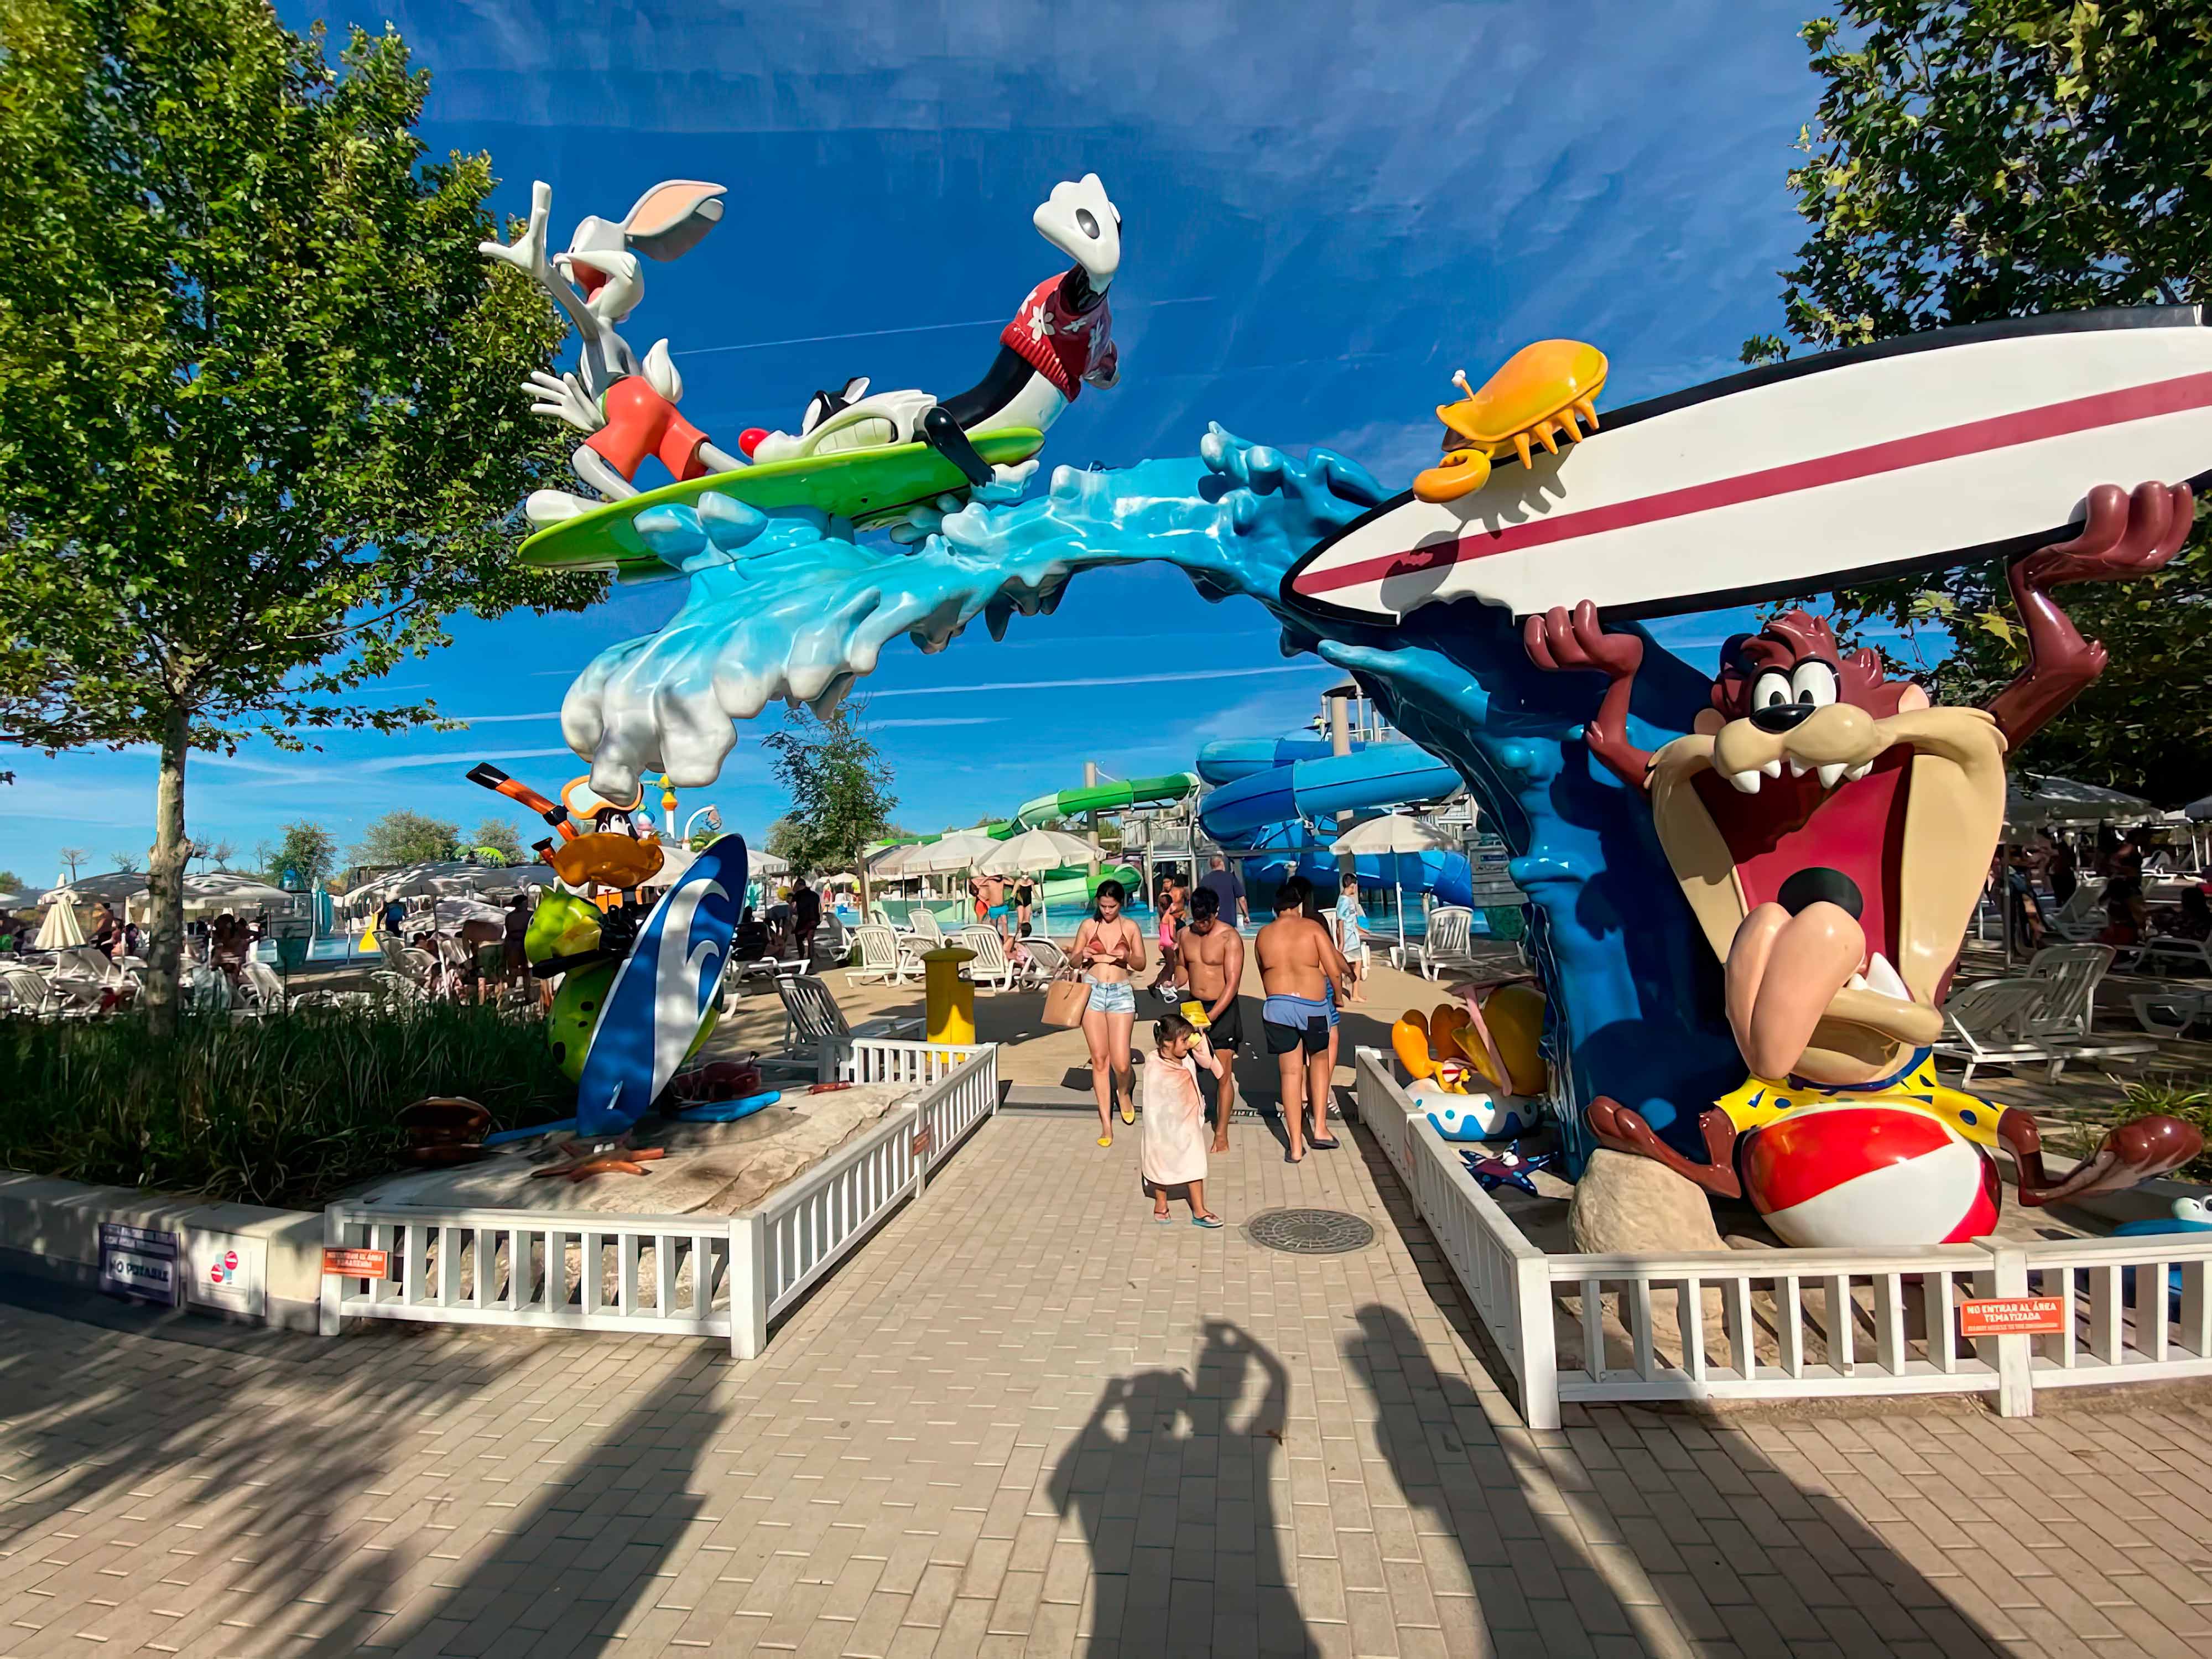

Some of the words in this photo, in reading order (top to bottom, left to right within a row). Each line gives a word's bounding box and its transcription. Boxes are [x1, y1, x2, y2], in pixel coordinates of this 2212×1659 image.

[1967, 1306, 1980, 1314] NO
[1982, 1304, 2017, 1313] ENTRAR
[2020, 1303, 2031, 1312] AL
[2033, 1301, 2057, 1310] ÁREA
[1984, 1313, 2041, 1323] TEMATIZADA
